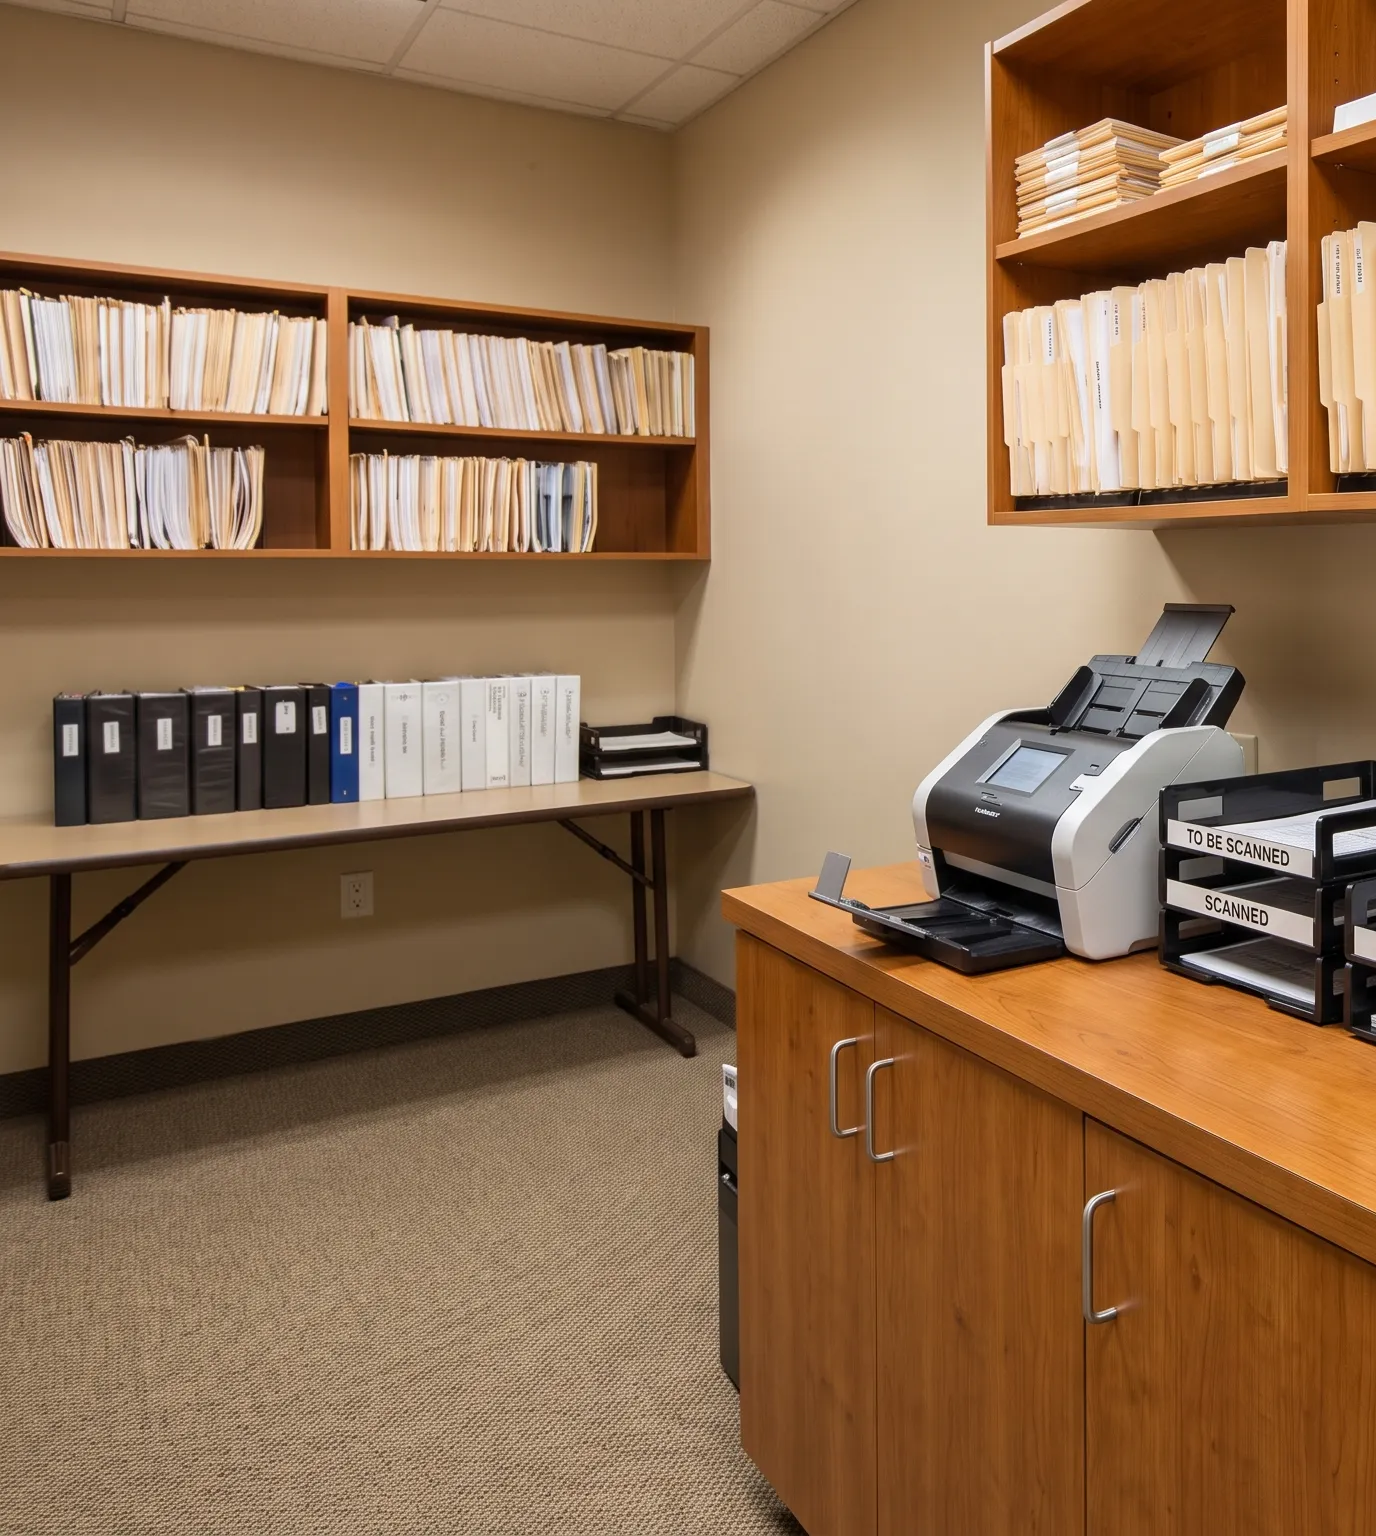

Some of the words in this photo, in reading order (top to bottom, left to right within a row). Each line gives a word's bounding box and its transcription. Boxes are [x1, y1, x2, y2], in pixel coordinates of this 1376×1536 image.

[1187, 828, 1203, 845] TO
[1206, 832, 1223, 851] BE
[1226, 837, 1290, 867] SCANNED
[1204, 894, 1269, 927] SCANNED
